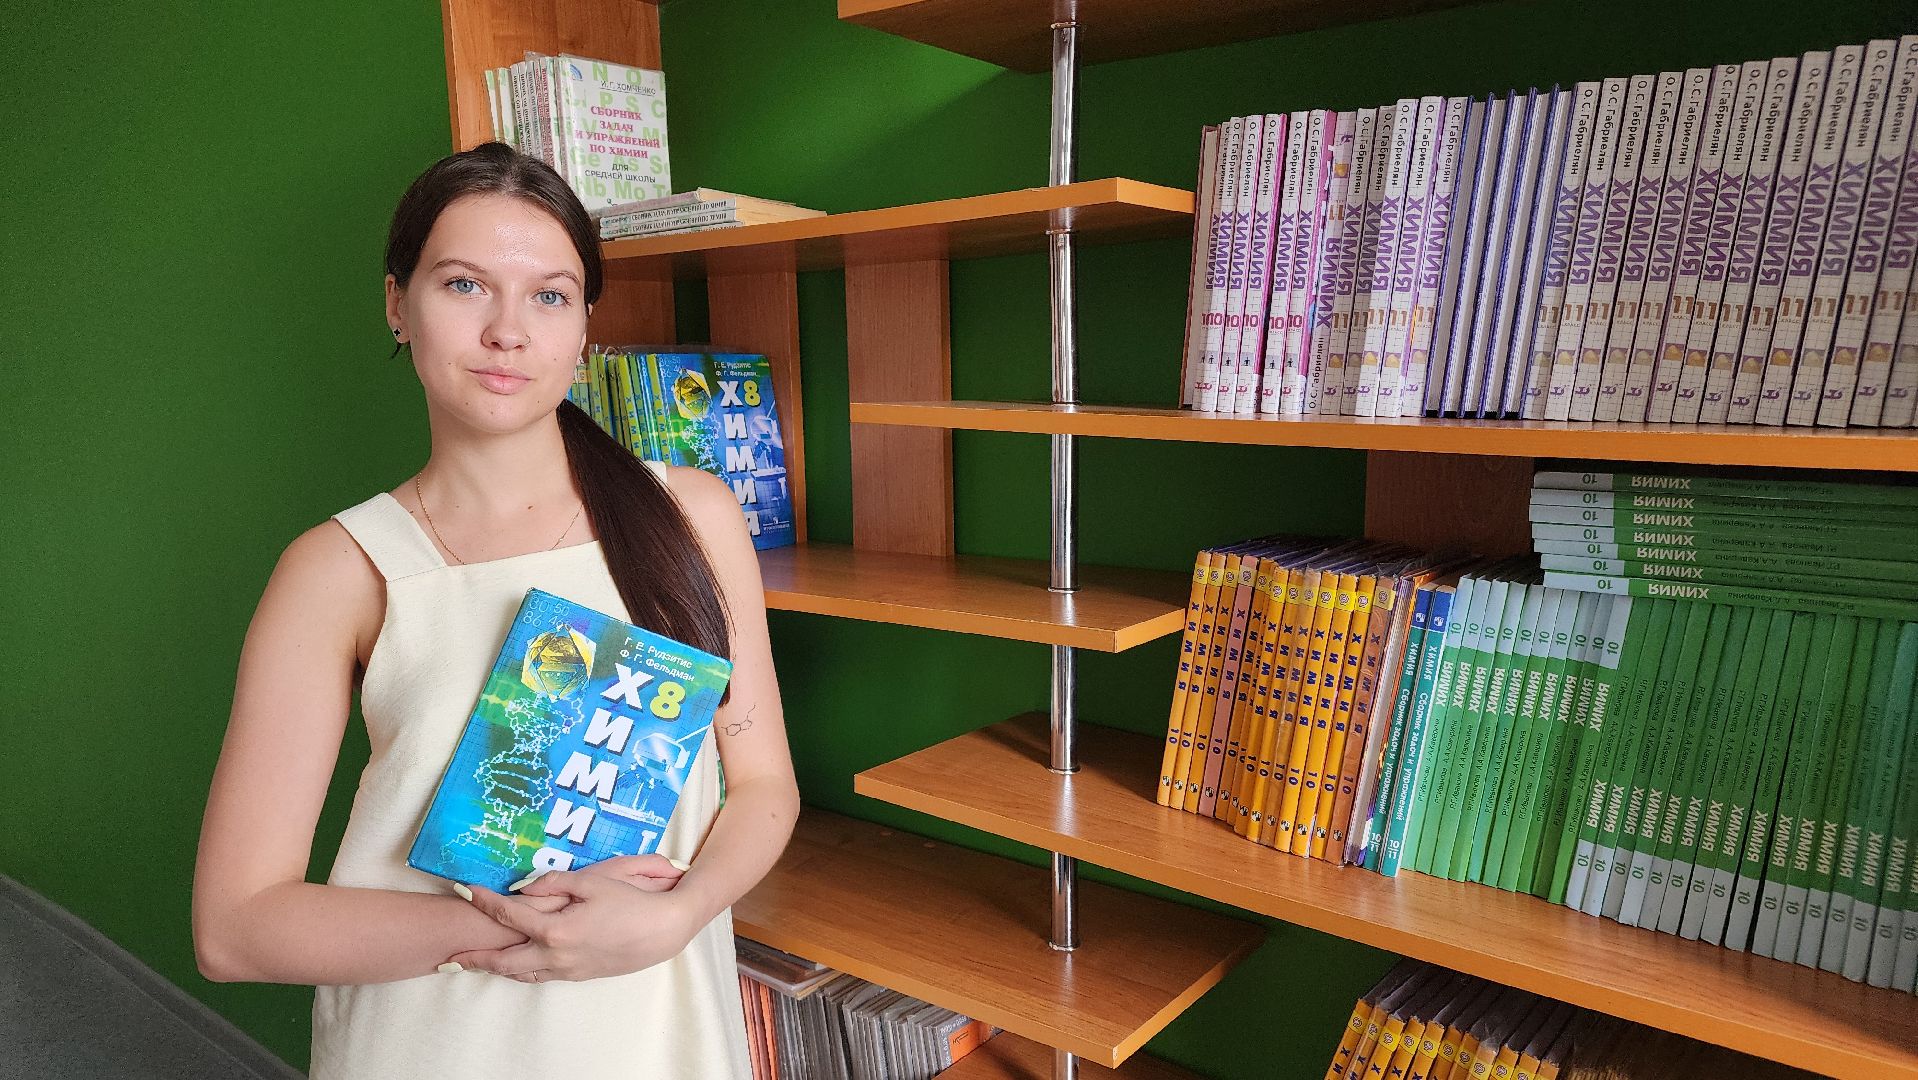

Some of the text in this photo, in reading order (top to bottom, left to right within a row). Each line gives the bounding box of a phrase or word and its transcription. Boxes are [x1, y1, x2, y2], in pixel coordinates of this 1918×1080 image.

[575, 129, 661, 149] И УПРАЖНЕНИЙ
[590, 105, 643, 121] СБОРНИК
[600, 120, 634, 133] ЗАДАЧ
[584, 169, 656, 183] СРЕДНЕЙ ШКОЛЫ
[589, 143, 648, 160] ПО ХИМИИ
[611, 163, 629, 172] ДЛЯ
[1545, 185, 1580, 288] ХИМИЯ
[1570, 182, 1605, 284] ХИМИЯ
[1597, 178, 1634, 282] ХИМИЯ
[1623, 175, 1661, 281] ХИМИЯ
[1649, 175, 1689, 282] ХИМИЯ
[1679, 168, 1720, 275] ХИМИЯ
[1703, 171, 1744, 282] ХИМИЯ
[1729, 174, 1770, 283] ХИМИЯ
[1759, 174, 1801, 286] ХИМИЯ
[1788, 162, 1834, 276] ХИМИЯ
[1853, 154, 1903, 273] ХИМИЯ
[1214, 210, 1234, 288] ХИМИЯ
[1249, 210, 1268, 289] ХИМИЯ
[1274, 212, 1294, 291] ХИМИЯ
[1293, 210, 1312, 289] ХИМИЯ
[1337, 204, 1362, 295] ХИМИЯ
[1373, 195, 1400, 290] ХИМИЯ
[1395, 197, 1424, 292] ХИМИЯ
[1423, 193, 1451, 288] ХИМИЯ
[1316, 237, 1341, 328] ХИМИЯ
[1672, 295, 1694, 315] 11
[1845, 294, 1869, 315] 11
[1226, 314, 1240, 328] 10
[1270, 316, 1285, 330] 10
[1333, 312, 1348, 328] 11
[1391, 309, 1407, 326] 11
[1591, 302, 1609, 320] 11
[1752, 306, 1773, 326] 11
[743, 380, 762, 408] 8
[1582, 473, 1692, 490] ХИМИЯ 10
[1582, 510, 1695, 528] ХИМИЯ 10
[1633, 531, 1695, 546] ХИМИЯ
[1587, 543, 1698, 562] ХИМИЯ 10
[1643, 563, 1704, 579] ХИМИЯ
[1597, 579, 1710, 600] ХИМИЯ 10
[523, 610, 542, 627] 86
[619, 649, 695, 682] Ф. Г. Фельдман
[624, 636, 633, 648] Г.
[647, 645, 693, 669] Рудзитис
[1178, 601, 1199, 691] ХИМИЯ
[1191, 604, 1213, 694] ХИМИЯ
[1223, 608, 1246, 699] ХИМИЯ
[1238, 609, 1263, 701] ХИМИЯ
[1254, 621, 1277, 716] ХИМИЯ
[1269, 623, 1294, 719] ХИМИЯ
[1405, 641, 1420, 676] ХИМИЯ
[1424, 645, 1438, 681] ХИМИЯ
[1435, 660, 1454, 708] ХИМИЯ
[1450, 622, 1462, 635] 10
[1486, 667, 1506, 715] ХИМИЯ
[1502, 627, 1514, 641] 10
[649, 681, 687, 722] 8
[1298, 628, 1325, 727] ХИМИЯ
[1317, 630, 1344, 730] ХИМИЯ
[1335, 631, 1362, 732] ХИМИЯ
[1354, 632, 1381, 734] ХИМИЯ
[1468, 666, 1487, 714] ХИМИЯ
[1504, 668, 1524, 717] ХИМИЯ
[1521, 670, 1541, 719] ХИМИЯ
[1538, 672, 1559, 721] ХИМИЯ
[1557, 674, 1578, 724] ХИМИЯ
[1574, 634, 1587, 648] 10
[1589, 682, 1611, 733] ХИМИЯ
[1606, 641, 1619, 656] 10
[1395, 688, 1411, 727] Сборник
[1413, 692, 1429, 732] Сборник
[1391, 726, 1401, 753] задач
[1408, 731, 1420, 758] задач
[528, 662, 655, 878] ХИМИЯ
[1378, 762, 1395, 815] упражнений
[1395, 768, 1413, 821] упражнений
[1577, 778, 1607, 867] ХИМИЯ 10
[1603, 783, 1625, 833] ХИМИЯ
[1623, 785, 1645, 835] ХИМИЯ
[1641, 787, 1663, 838] ХИМИЯ
[1659, 793, 1682, 845] ХИМИЯ
[1680, 795, 1702, 847] ХИМИЯ
[1701, 799, 1724, 852] ХИМИЯ
[1722, 803, 1744, 857] ХИМИЯ
[1737, 809, 1769, 905] ХИМИЯ 10
[1772, 814, 1794, 867] ХИМИЯ
[1786, 817, 1816, 915] ХИМИЯ 10
[1816, 820, 1839, 875] ХИМИЯ
[1861, 831, 1884, 887] ХИМИЯ
[1631, 865, 1645, 880] 10
[1671, 874, 1685, 889] 10
